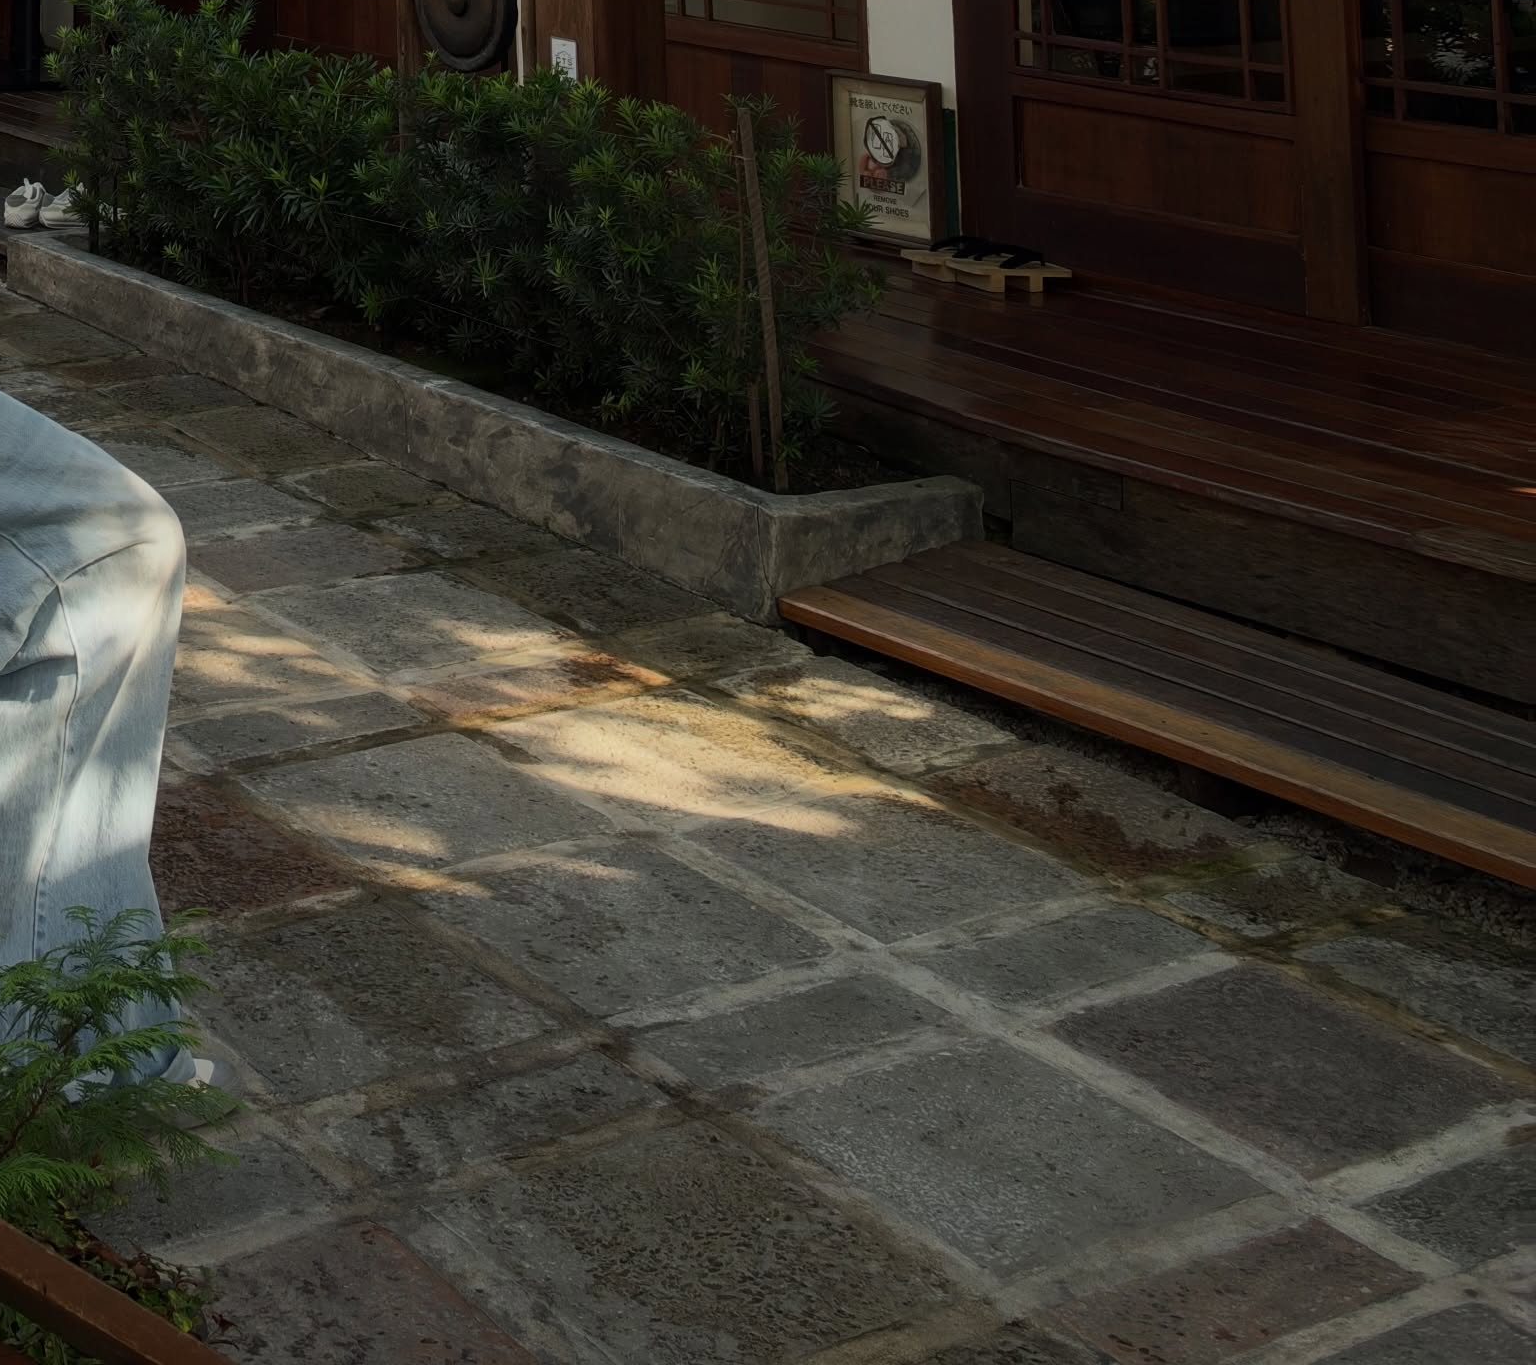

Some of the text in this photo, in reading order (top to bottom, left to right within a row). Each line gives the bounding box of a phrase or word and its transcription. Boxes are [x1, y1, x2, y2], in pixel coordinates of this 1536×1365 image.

[863, 175, 904, 195] PLEASE
[873, 195, 897, 206] REMOVE
[885, 206, 910, 219] SHOES
